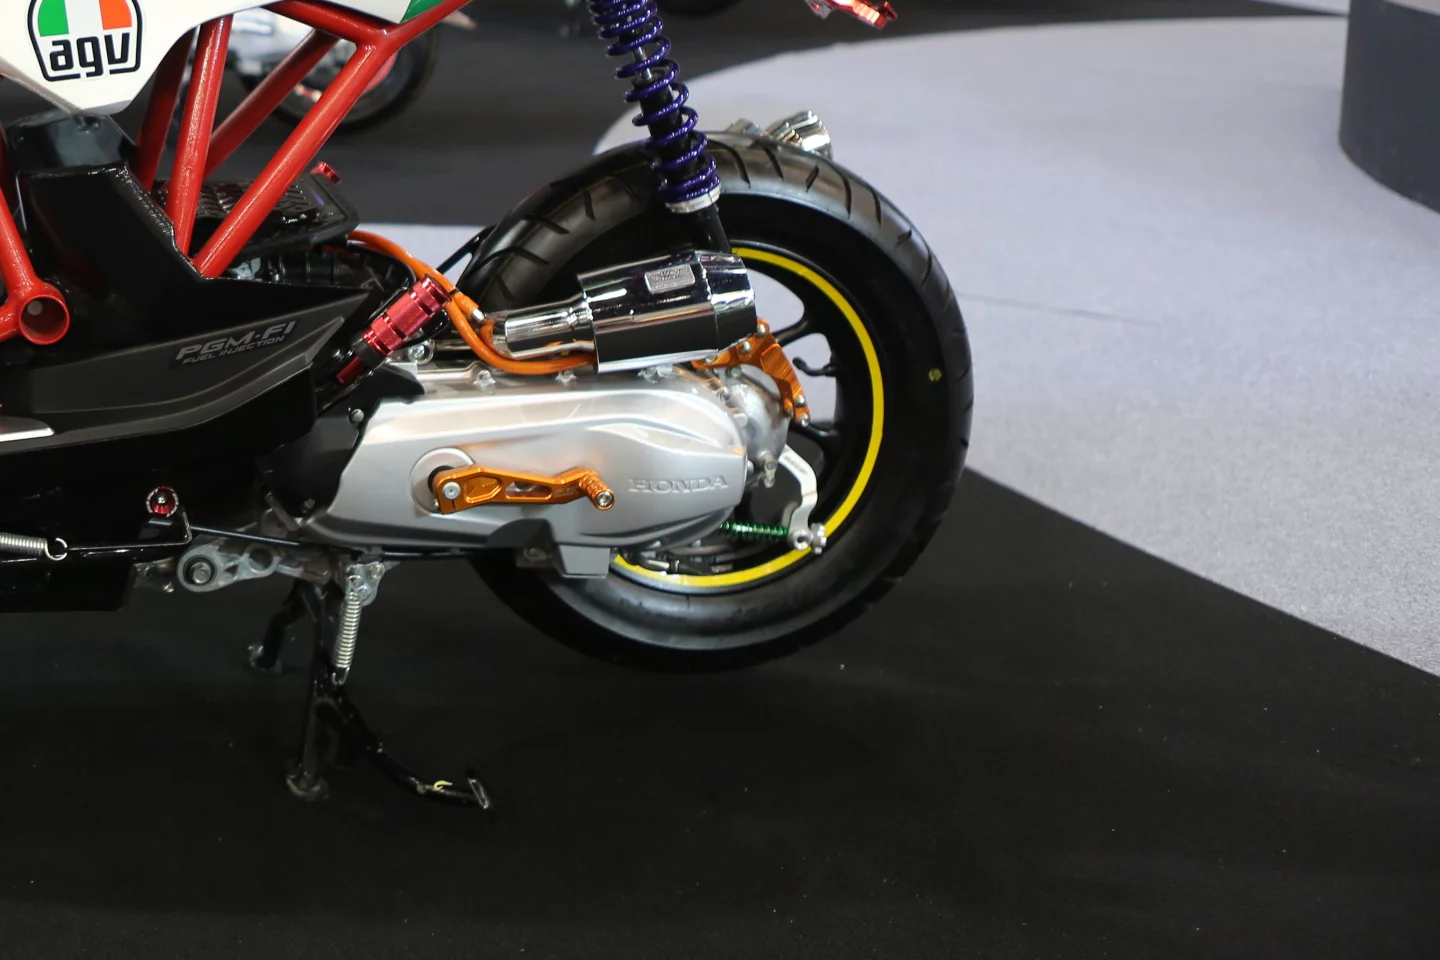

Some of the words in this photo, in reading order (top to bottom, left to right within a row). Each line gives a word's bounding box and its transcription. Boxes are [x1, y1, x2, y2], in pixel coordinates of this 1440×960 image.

[49, 32, 130, 78] agv
[182, 353, 216, 365] FUEL
[219, 335, 285, 357] INJECTION
[628, 475, 729, 494] HONDA
